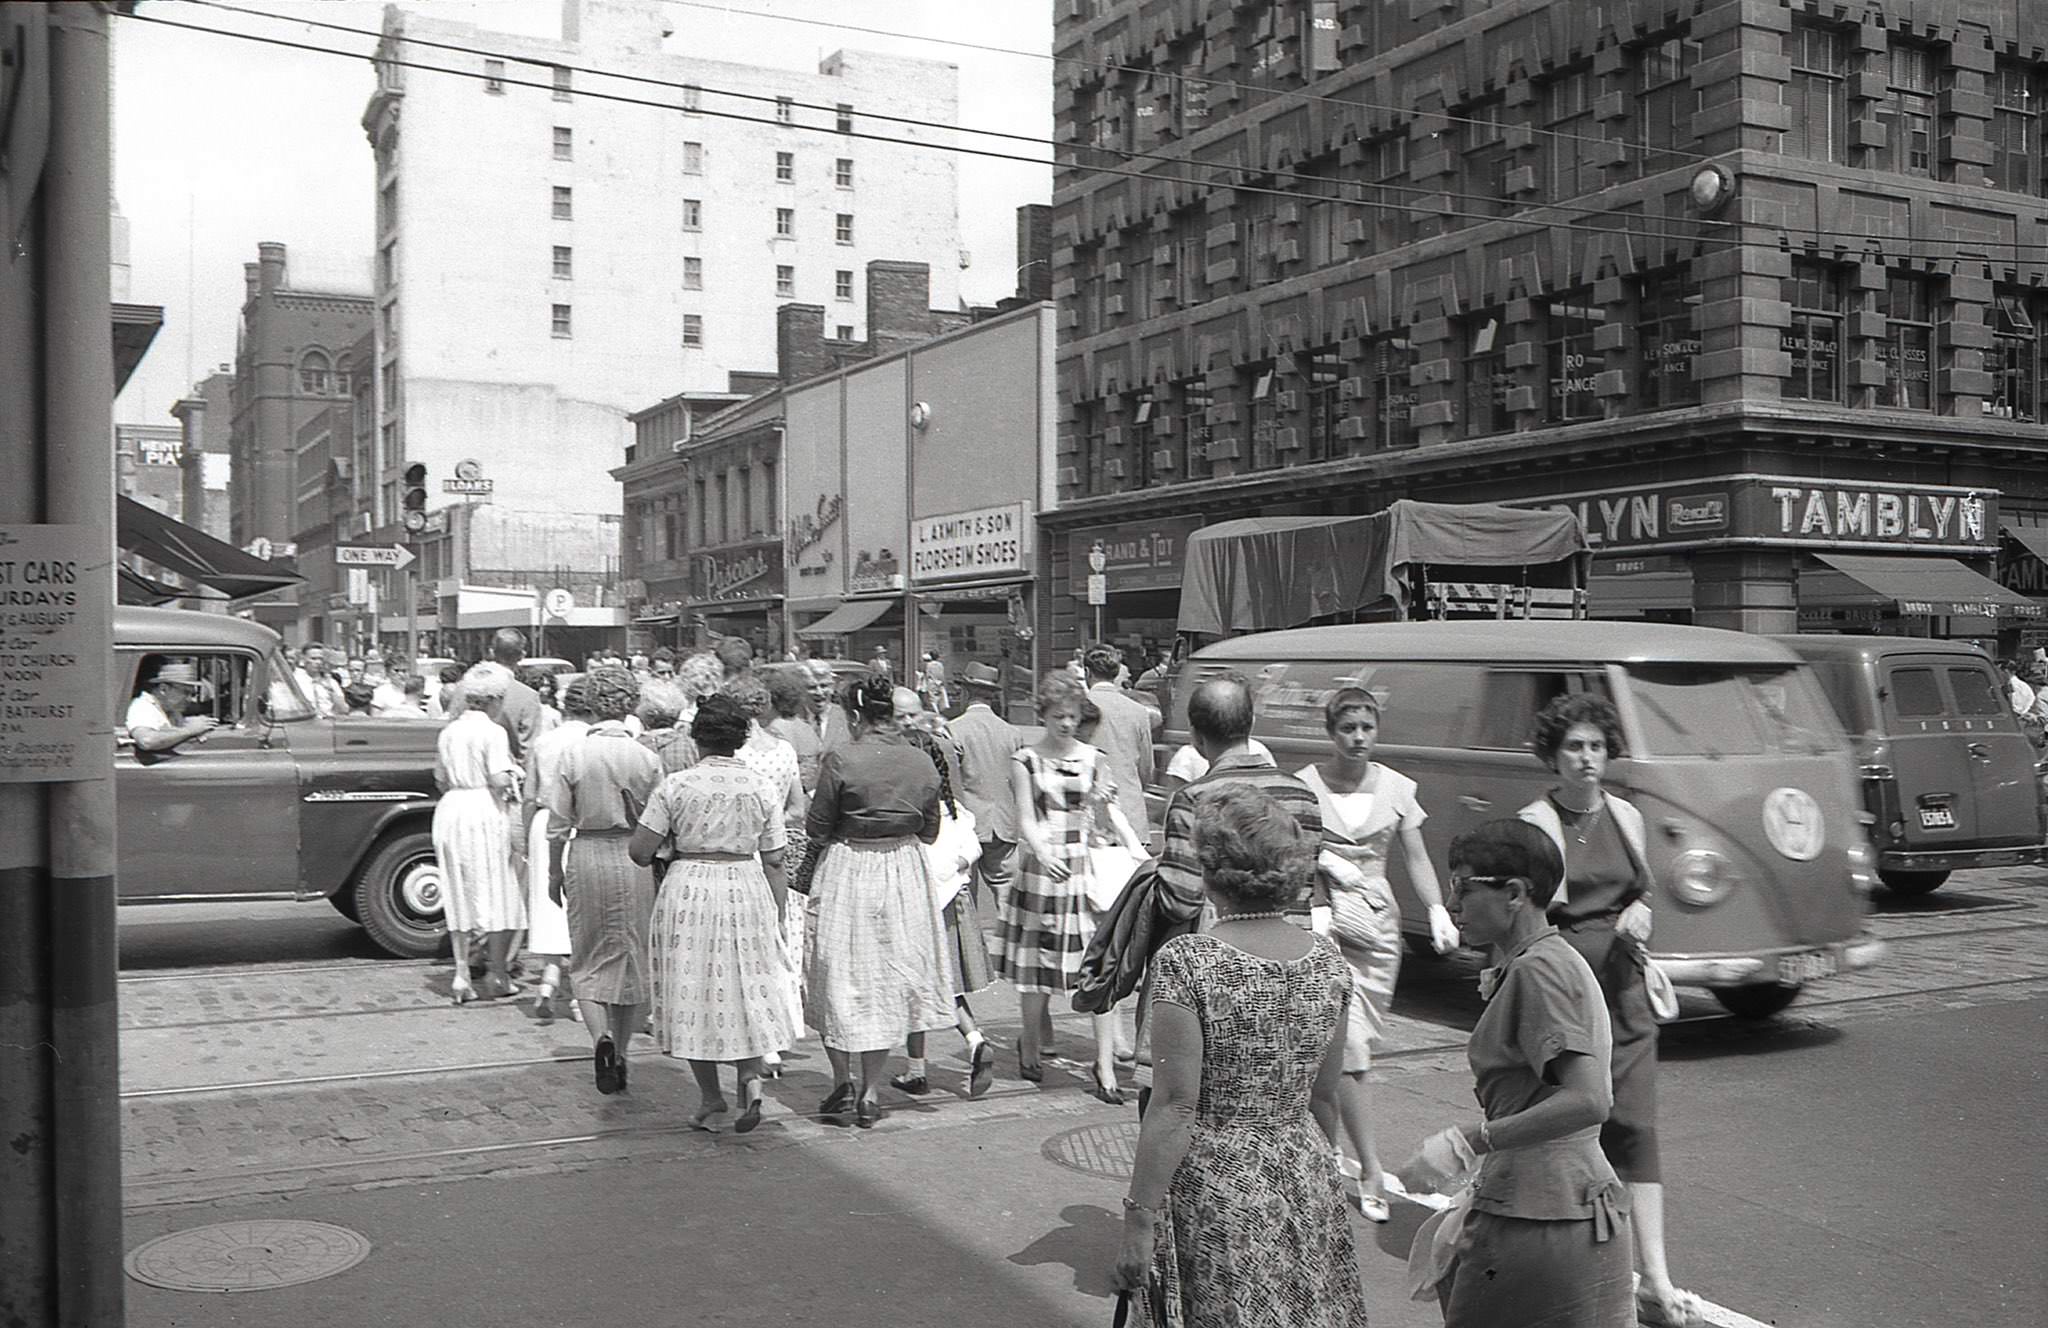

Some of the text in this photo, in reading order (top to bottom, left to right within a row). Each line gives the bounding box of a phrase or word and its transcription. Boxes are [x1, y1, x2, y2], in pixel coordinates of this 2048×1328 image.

[1771, 486, 1985, 542] TAMBLYN
[987, 511, 1013, 534] SON
[343, 548, 401, 562] ONE WAY
[914, 538, 1018, 573] FLORSHEIM SHOES
[23, 560, 77, 584] CARS
[19, 611, 77, 626] AUGUST
[21, 653, 77, 668] CHURCH
[3, 670, 43, 682] NOON
[6, 704, 76, 719] BATHURST
